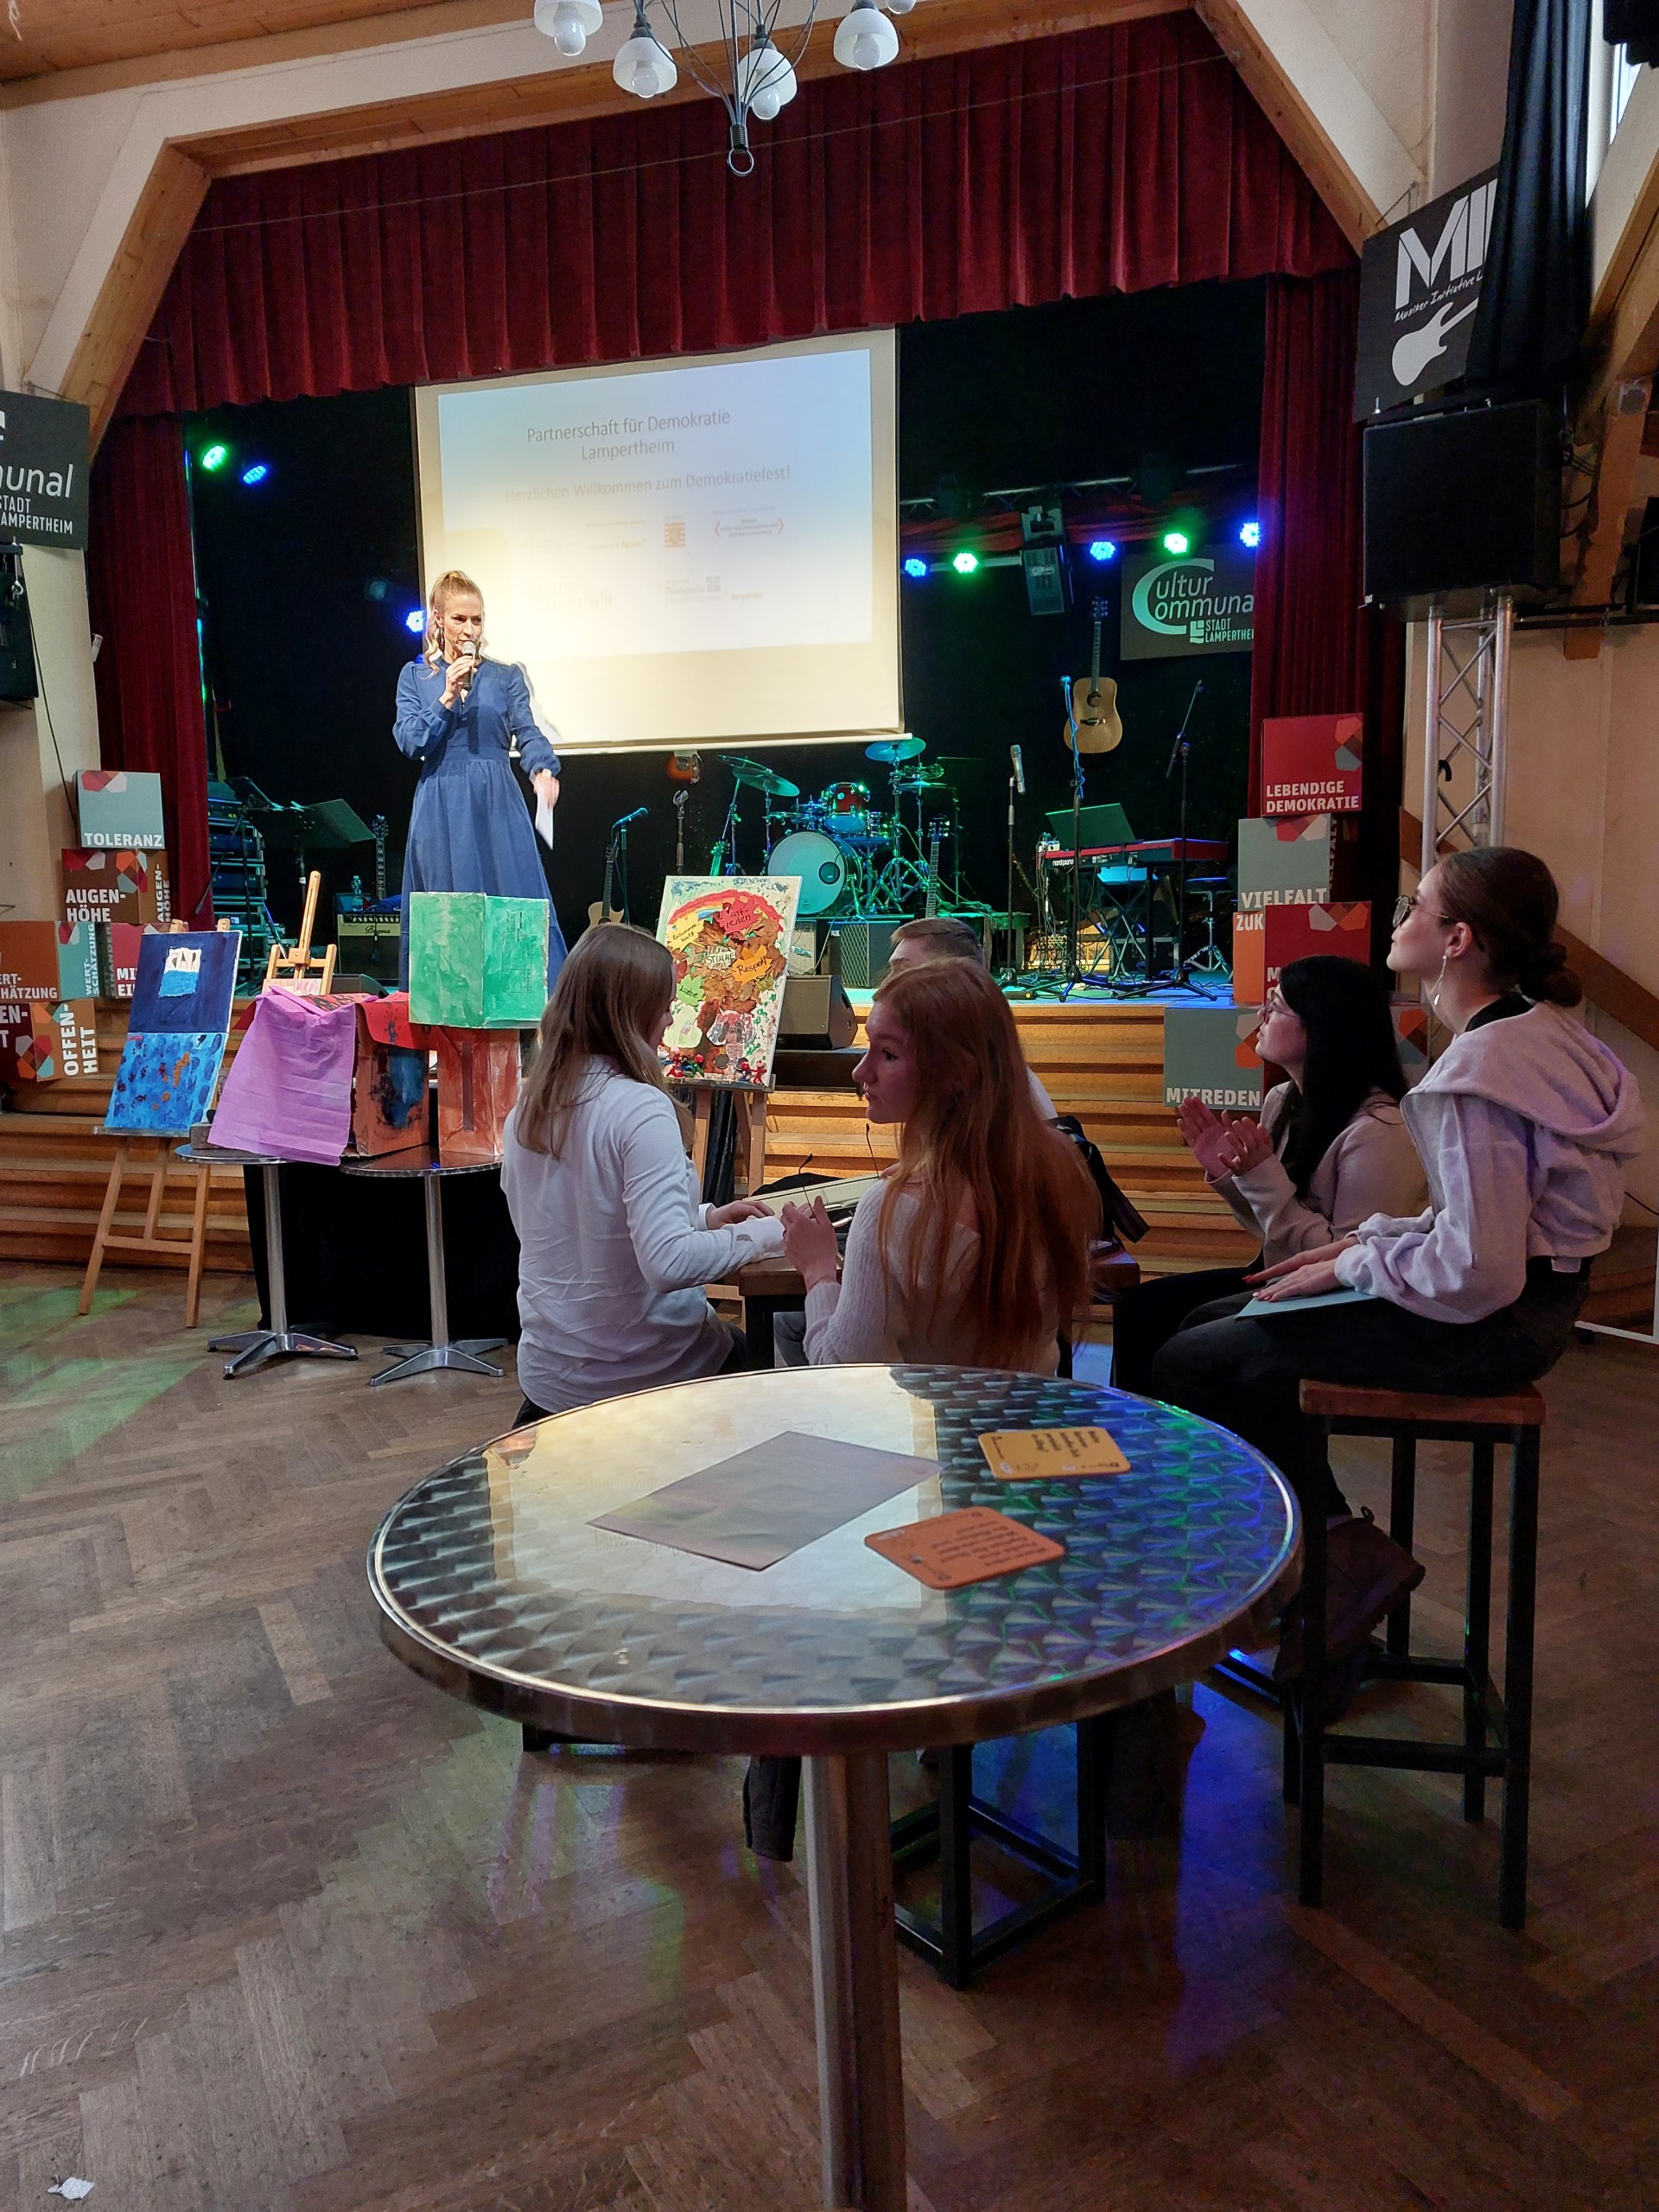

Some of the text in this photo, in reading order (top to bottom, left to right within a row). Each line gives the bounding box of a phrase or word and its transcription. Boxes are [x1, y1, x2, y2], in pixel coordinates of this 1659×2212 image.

[1394, 301, 1429, 323] Musiker
[1431, 276, 1473, 304] Initiative
[526, 409, 731, 442] Partnerschaft für Demokratie
[582, 439, 675, 461] Lampertheim
[0, 463, 73, 499] unal
[505, 464, 791, 502] Herzlichen Willkommen zum Demokratiefest!
[0, 511, 73, 535] AMPERTHEIM
[1205, 617, 1231, 632] STADT
[1205, 628, 1255, 643] LAMPERTHEI
[1266, 780, 1344, 798] LEBENDIGE
[1266, 795, 1359, 813] DEMOKRATIE
[84, 832, 163, 847] TOLERANZ
[66, 888, 126, 904] AUGEN-
[155, 864, 164, 923] AUGEN-
[162, 880, 172, 922] HÖHE
[1241, 887, 1327, 909] VIELFALT
[67, 904, 111, 923] HÖHE
[1236, 912, 1264, 931] ZUK
[87, 922, 99, 995] SCHÄTZUNG
[83, 958, 92, 996] WERT-
[117, 967, 137, 981] MI
[0, 984, 58, 1000] HÄTZUNG
[118, 983, 135, 997] EI
[678, 987, 699, 999] Liebe
[0, 1005, 29, 1024] EN-
[60, 1002, 79, 1077] OFFEN-
[79, 1026, 99, 1075] HEIT
[1166, 1087, 1261, 1107] MITREDEN
